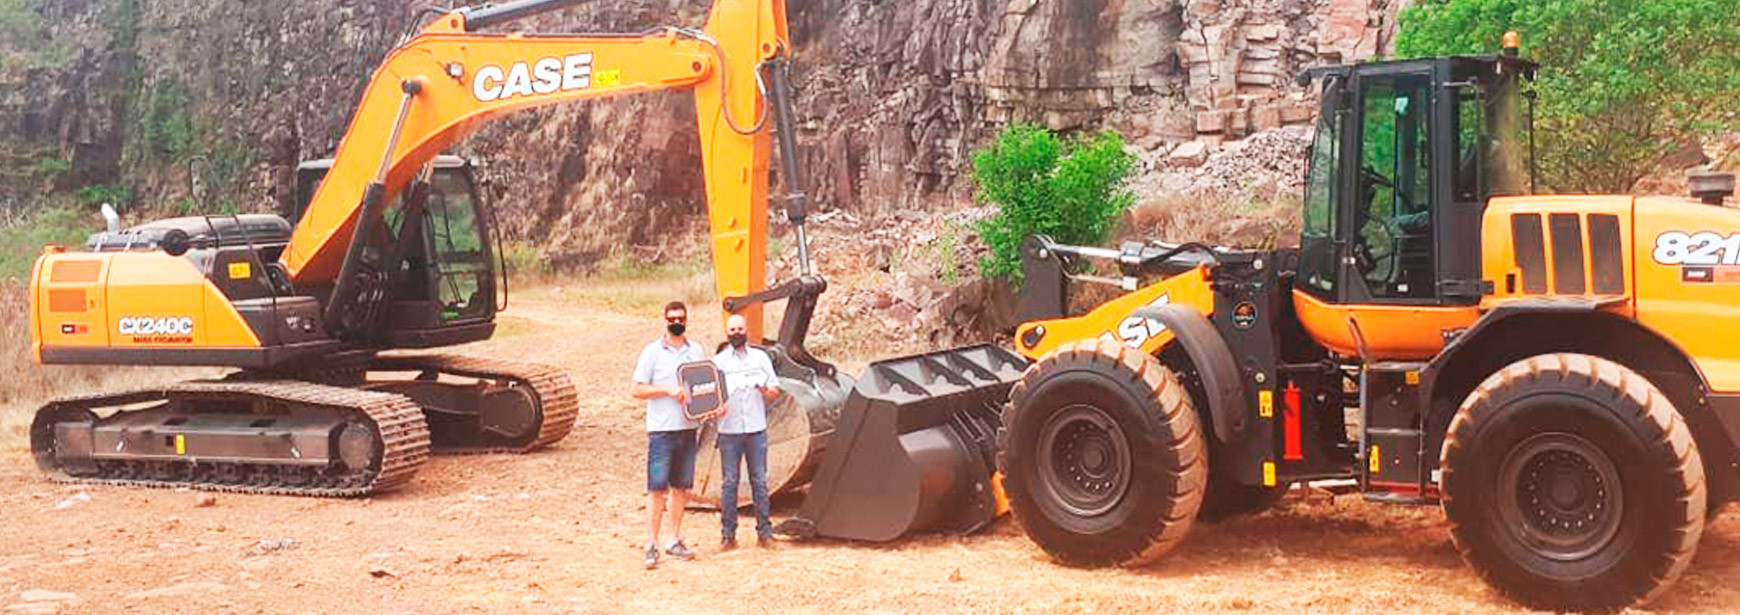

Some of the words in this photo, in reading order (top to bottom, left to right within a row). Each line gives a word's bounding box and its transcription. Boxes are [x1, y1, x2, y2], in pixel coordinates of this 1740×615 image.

[473, 51, 593, 102] CASE
[1652, 231, 1740, 265] 821
[118, 316, 193, 334] CX240C
